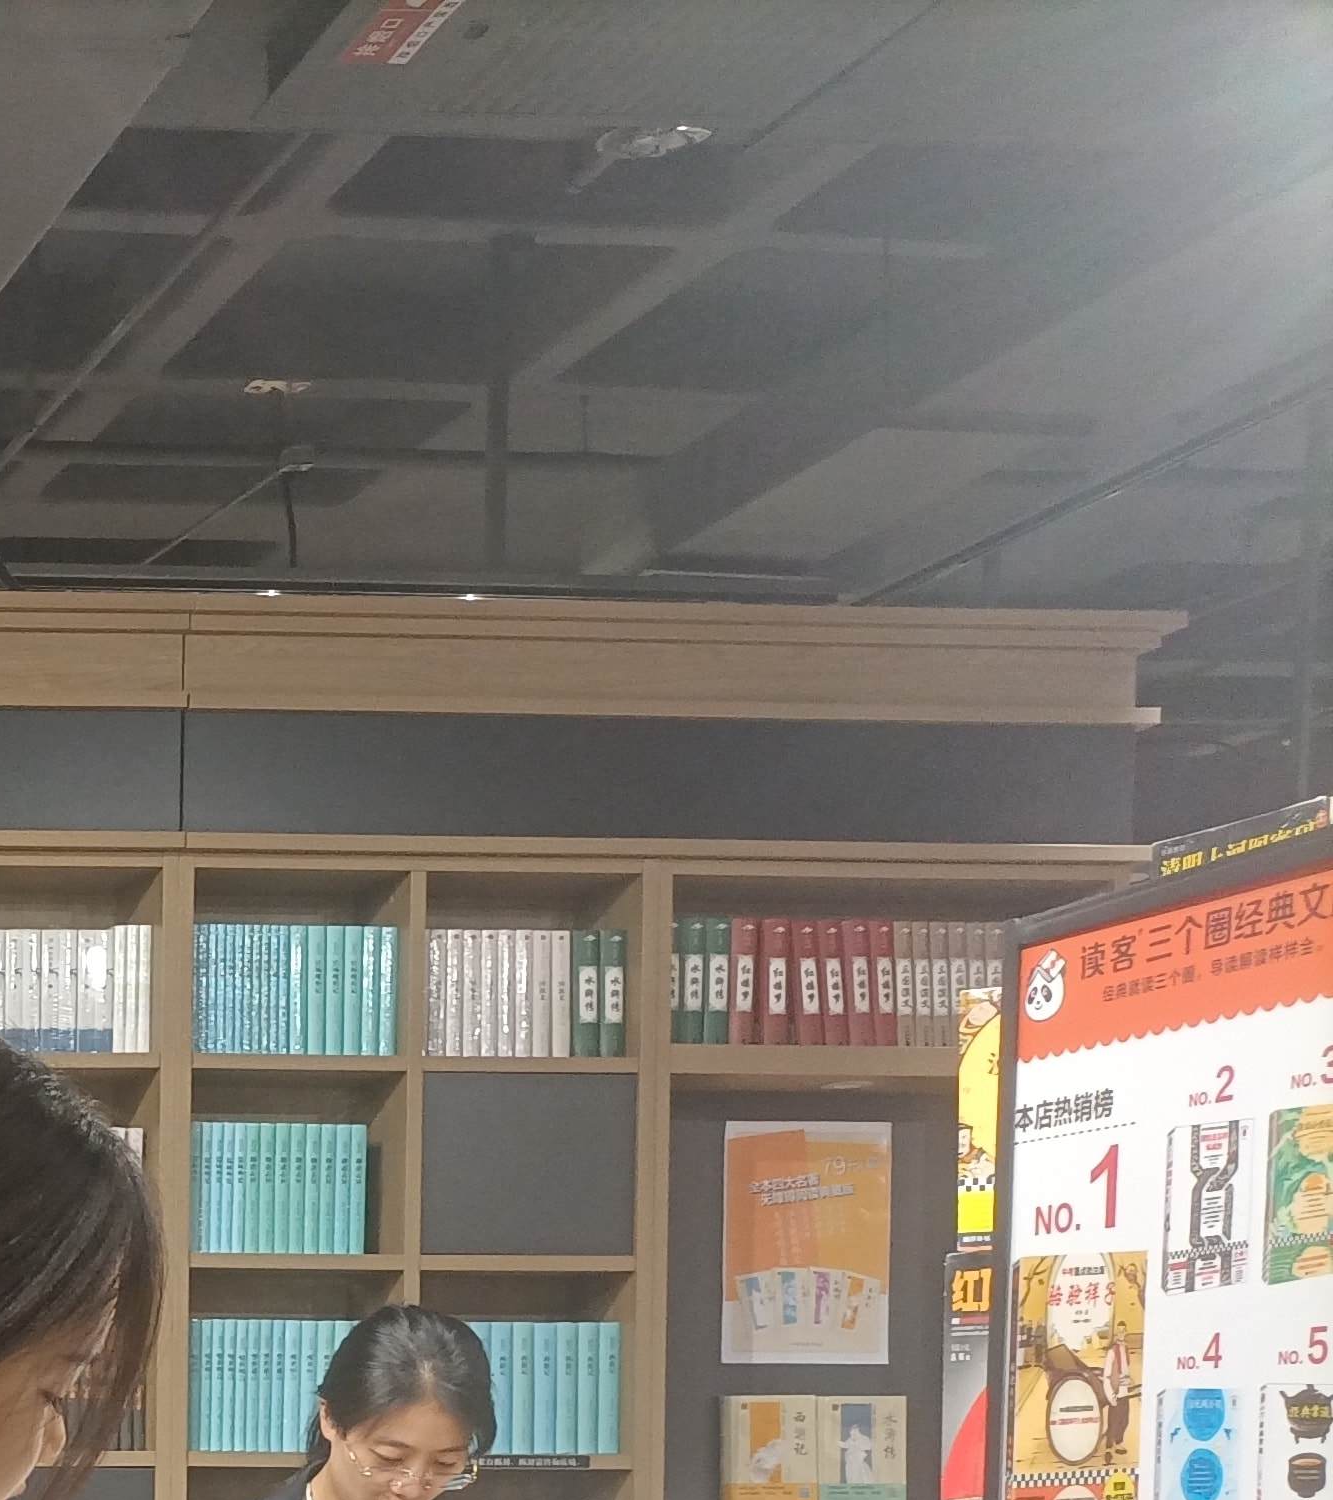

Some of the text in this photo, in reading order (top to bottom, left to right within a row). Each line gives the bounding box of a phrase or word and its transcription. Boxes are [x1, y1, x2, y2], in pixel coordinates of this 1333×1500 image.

[1080, 882, 1333, 980] 读客三个圈经典文
[1189, 1064, 1235, 1108] NO.2
[1014, 1088, 1114, 1133] 本店热销榜
[1034, 1144, 1120, 1236] NO.1
[1176, 1332, 1223, 1370] NO.4
[1278, 1326, 1329, 1365] NO.5
